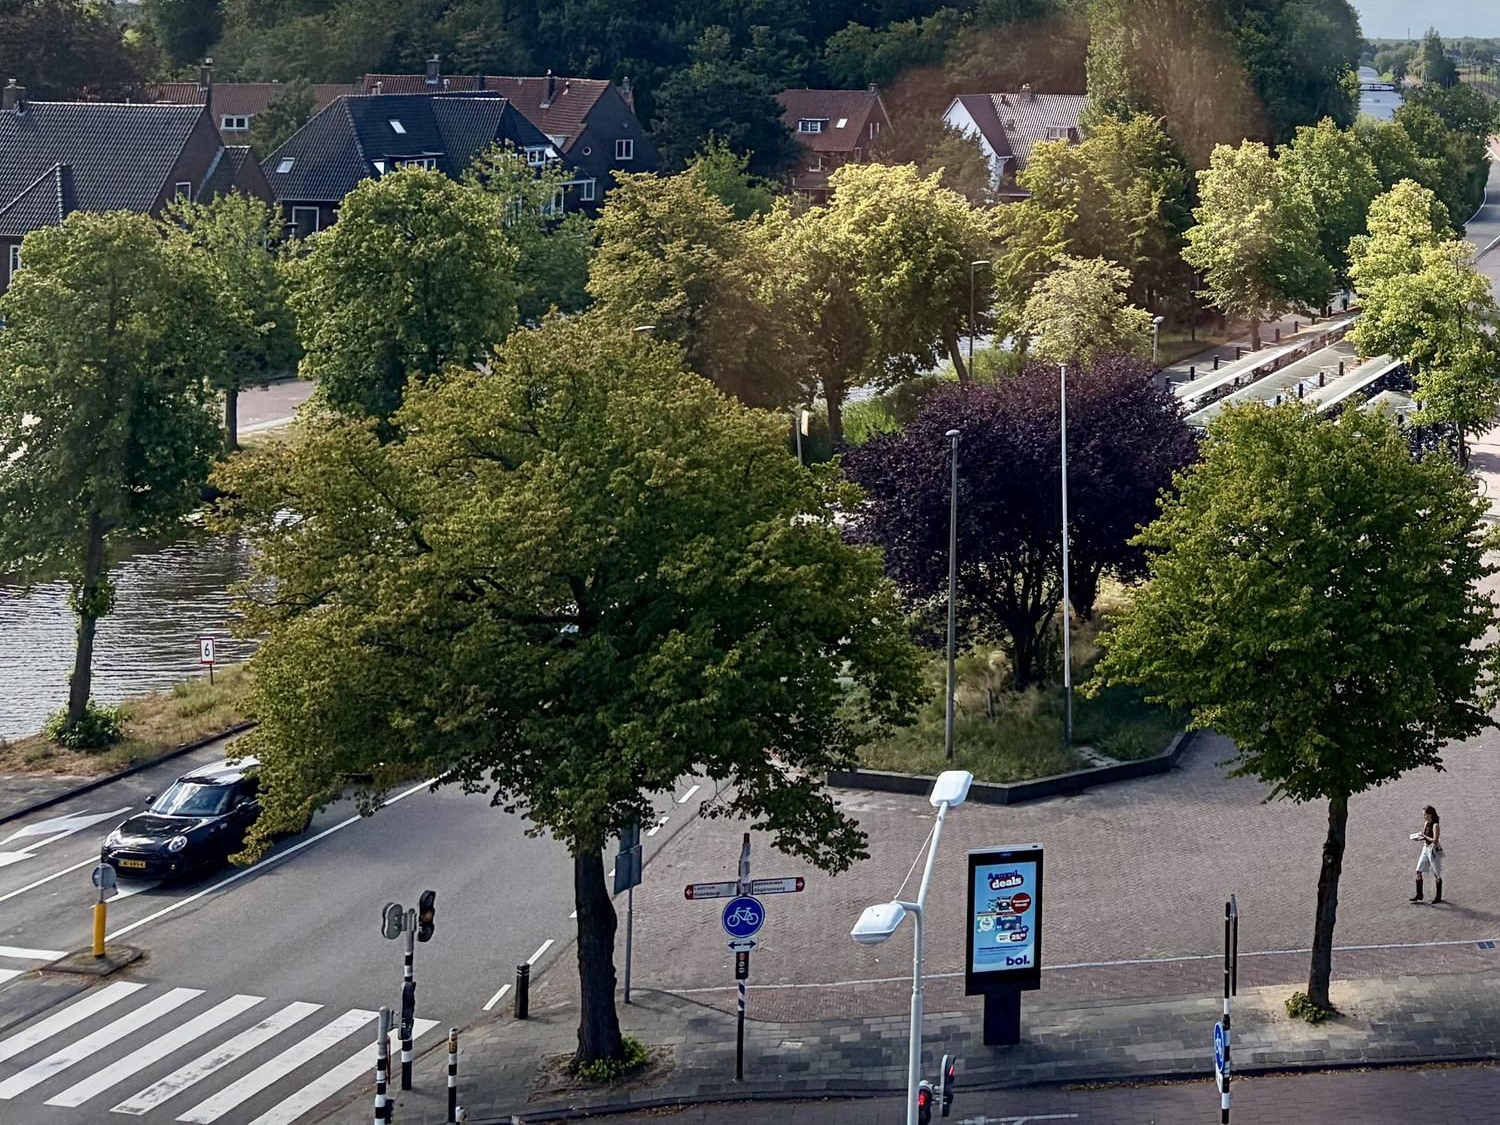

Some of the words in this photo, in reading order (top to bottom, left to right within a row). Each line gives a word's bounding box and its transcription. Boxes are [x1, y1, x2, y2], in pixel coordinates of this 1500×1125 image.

[204, 642, 211, 657] 6
[991, 876, 1022, 889] deals
[1006, 955, 1031, 966] bol.
